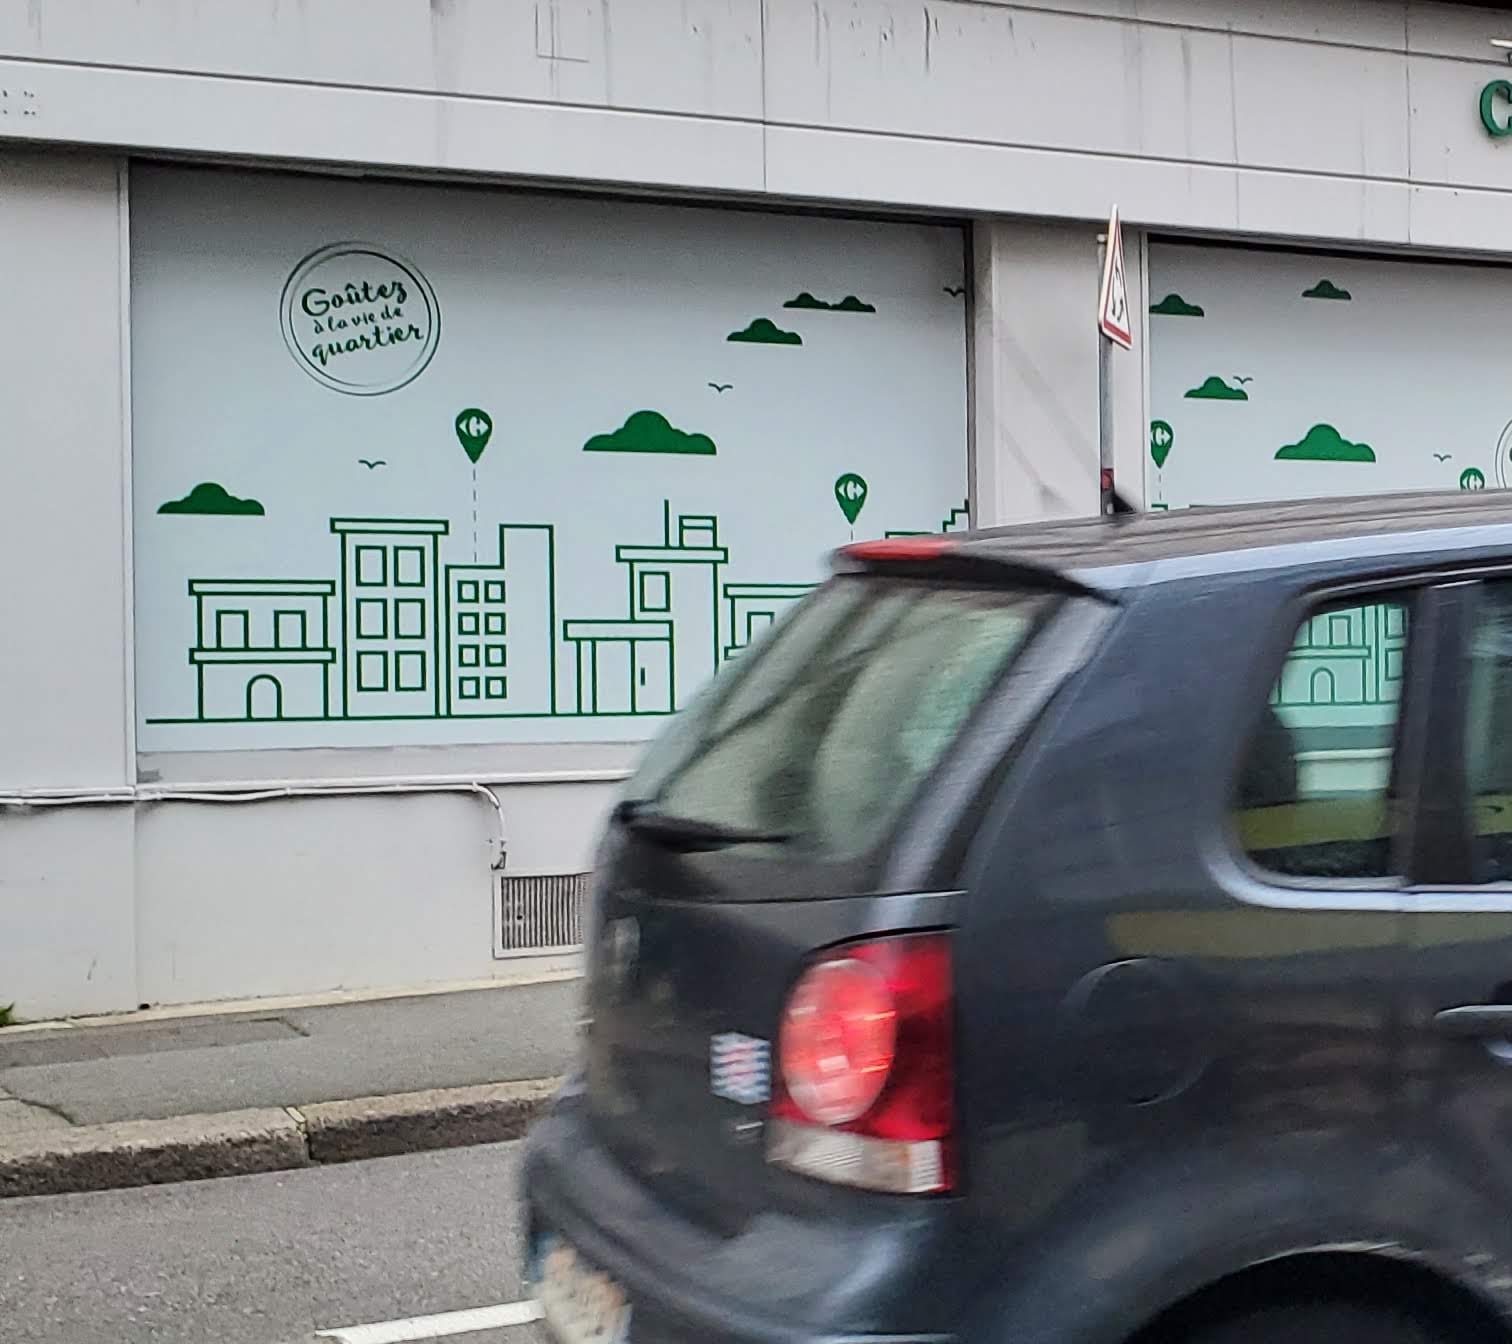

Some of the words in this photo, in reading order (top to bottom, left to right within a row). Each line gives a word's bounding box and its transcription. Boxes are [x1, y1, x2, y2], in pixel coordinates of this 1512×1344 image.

[302, 281, 407, 317] Goûtez
[314, 319, 324, 334] à
[328, 316, 348, 332] la
[352, 312, 375, 325] vie
[381, 304, 403, 320] de
[312, 324, 424, 366] quartier
